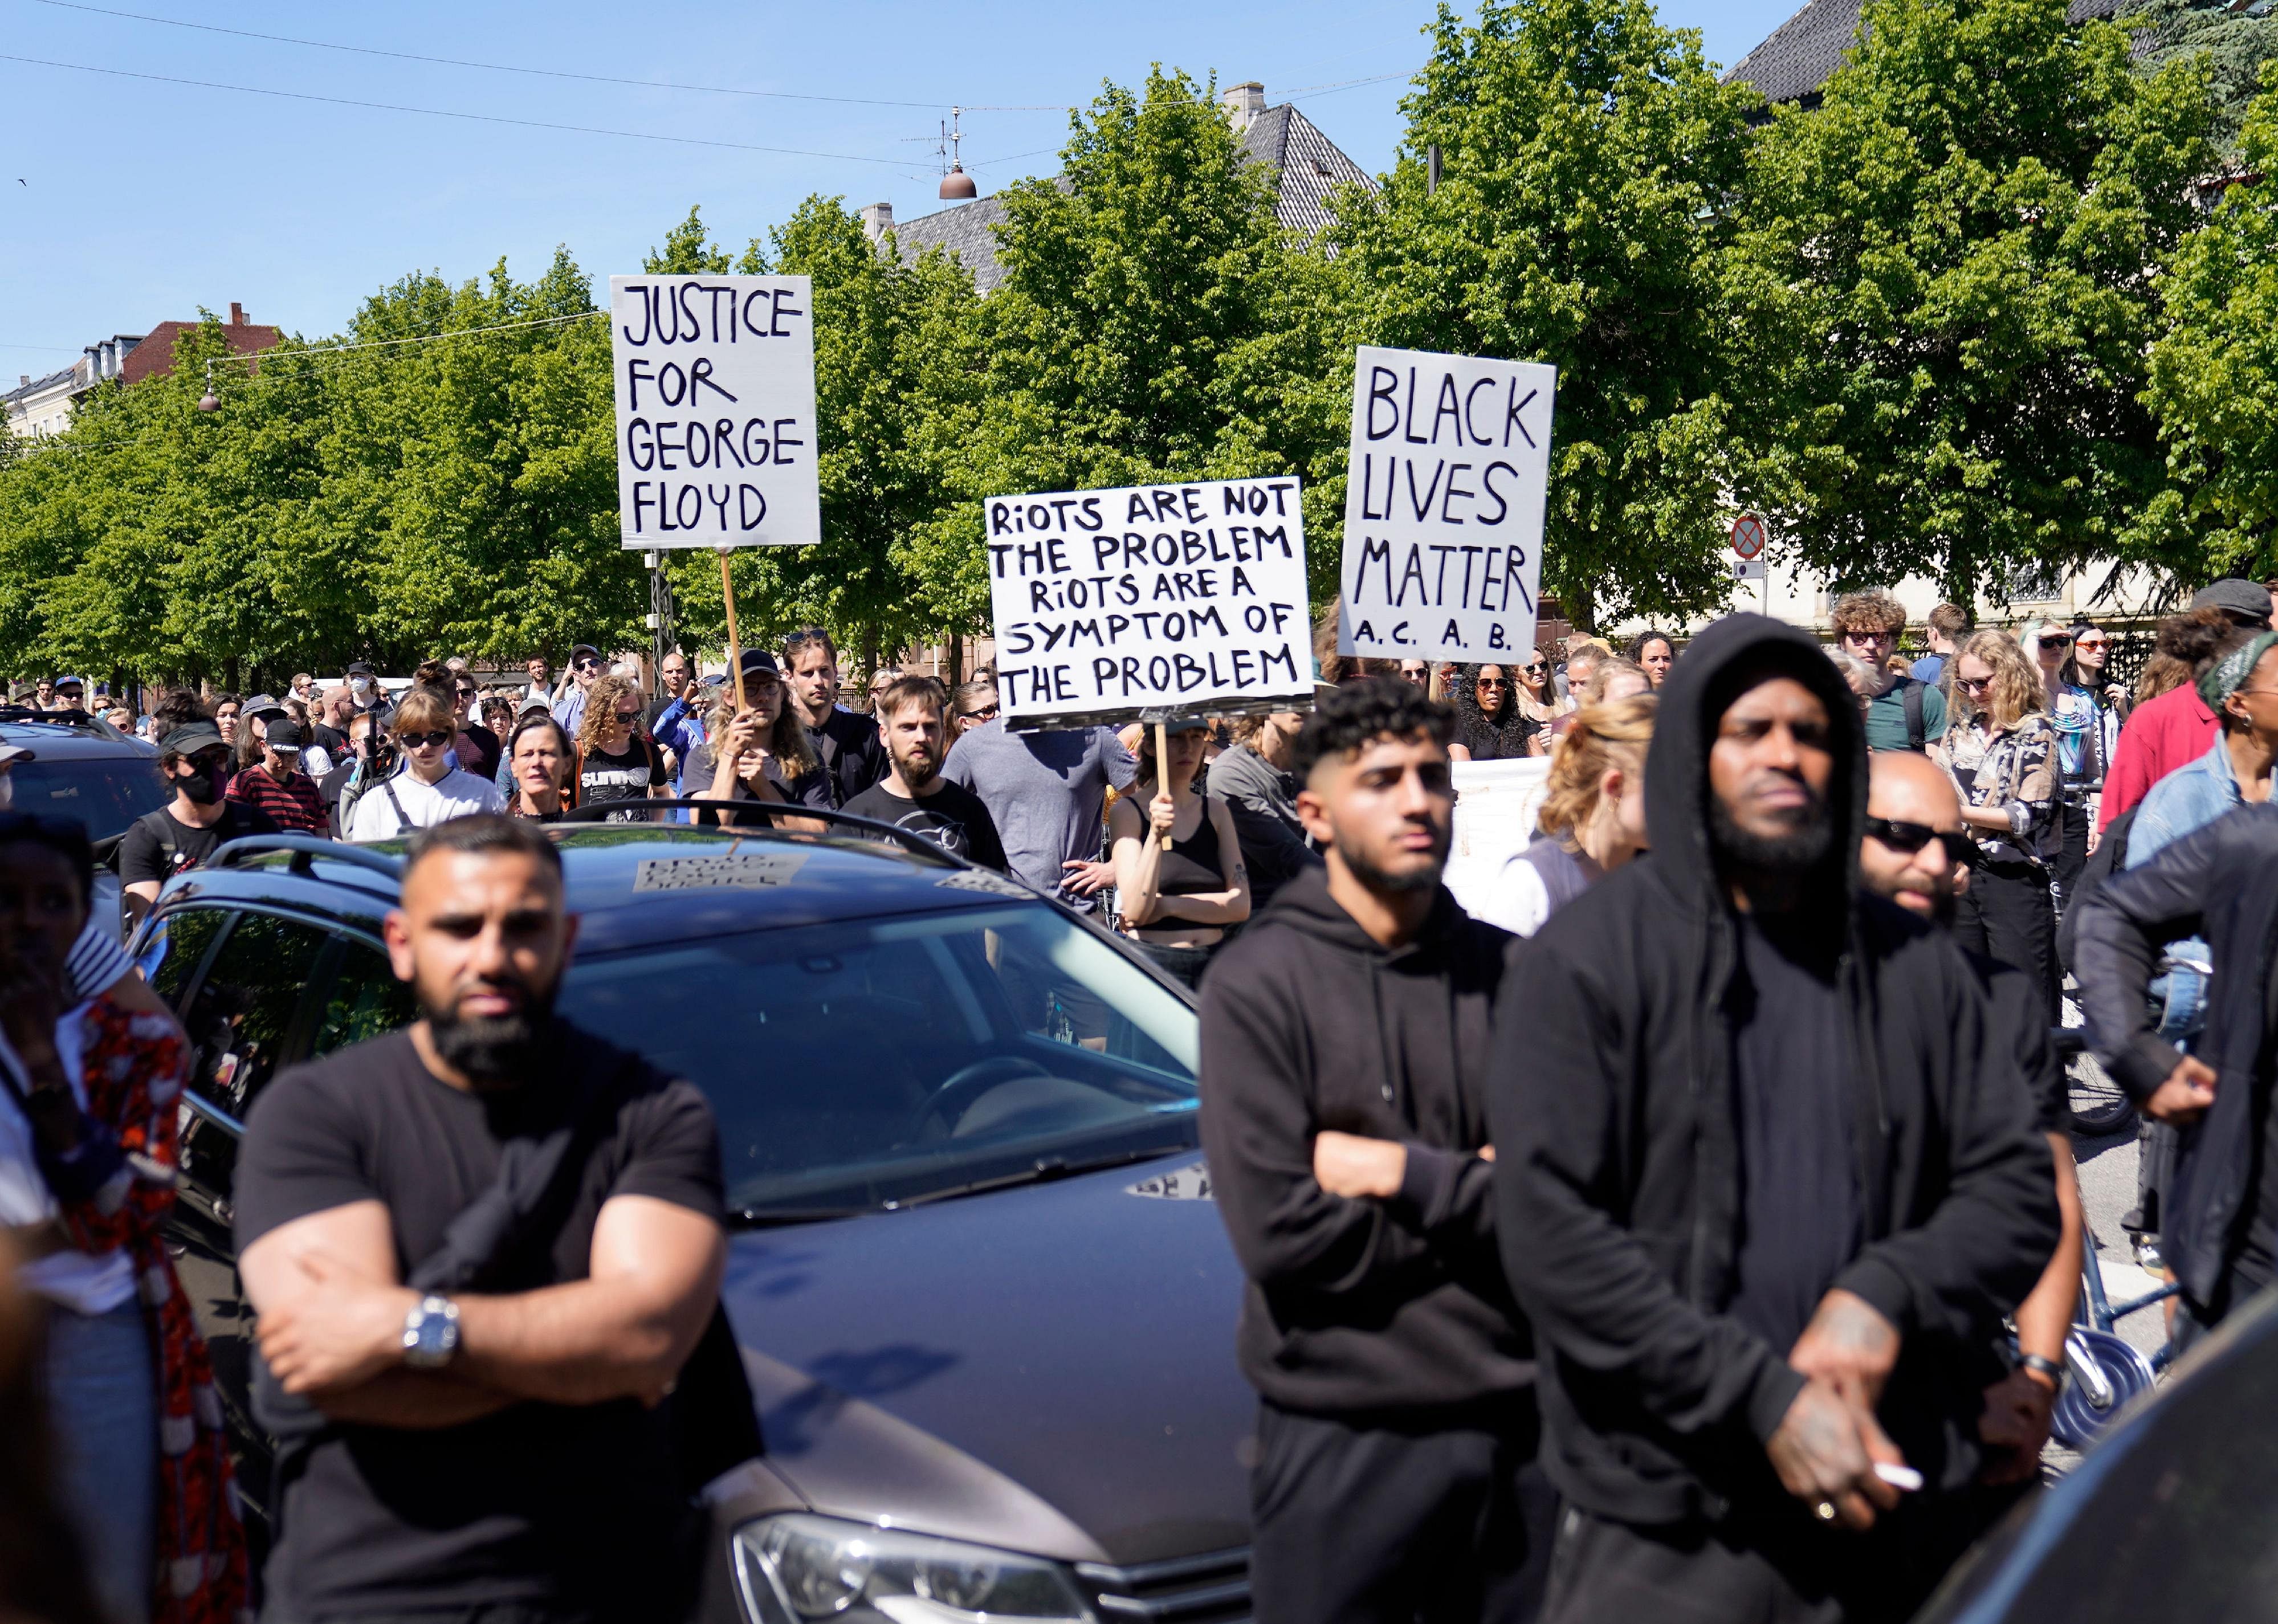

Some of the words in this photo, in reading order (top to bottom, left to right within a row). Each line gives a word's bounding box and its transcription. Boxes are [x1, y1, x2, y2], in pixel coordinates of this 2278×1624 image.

[624, 282, 802, 346] JUSTICE
[629, 358, 738, 411] FOR
[1367, 366, 1537, 448] BLACK
[627, 418, 803, 471] GEORGE
[633, 482, 766, 533] FLOYD
[1128, 488, 1208, 524] ARE
[1224, 484, 1294, 516] NOT
[1362, 454, 1518, 525] LIVES
[990, 539, 1071, 577] THE
[1094, 525, 1292, 570] PROBLEM
[1354, 537, 1533, 614] MATTER
[1153, 569, 1217, 601] ARE
[1232, 566, 1256, 595] A
[1003, 606, 1228, 654] SYMPTOM
[1245, 602, 1294, 634] OF
[1000, 665, 1078, 706] THE
[1094, 643, 1298, 697] PROBLEM
